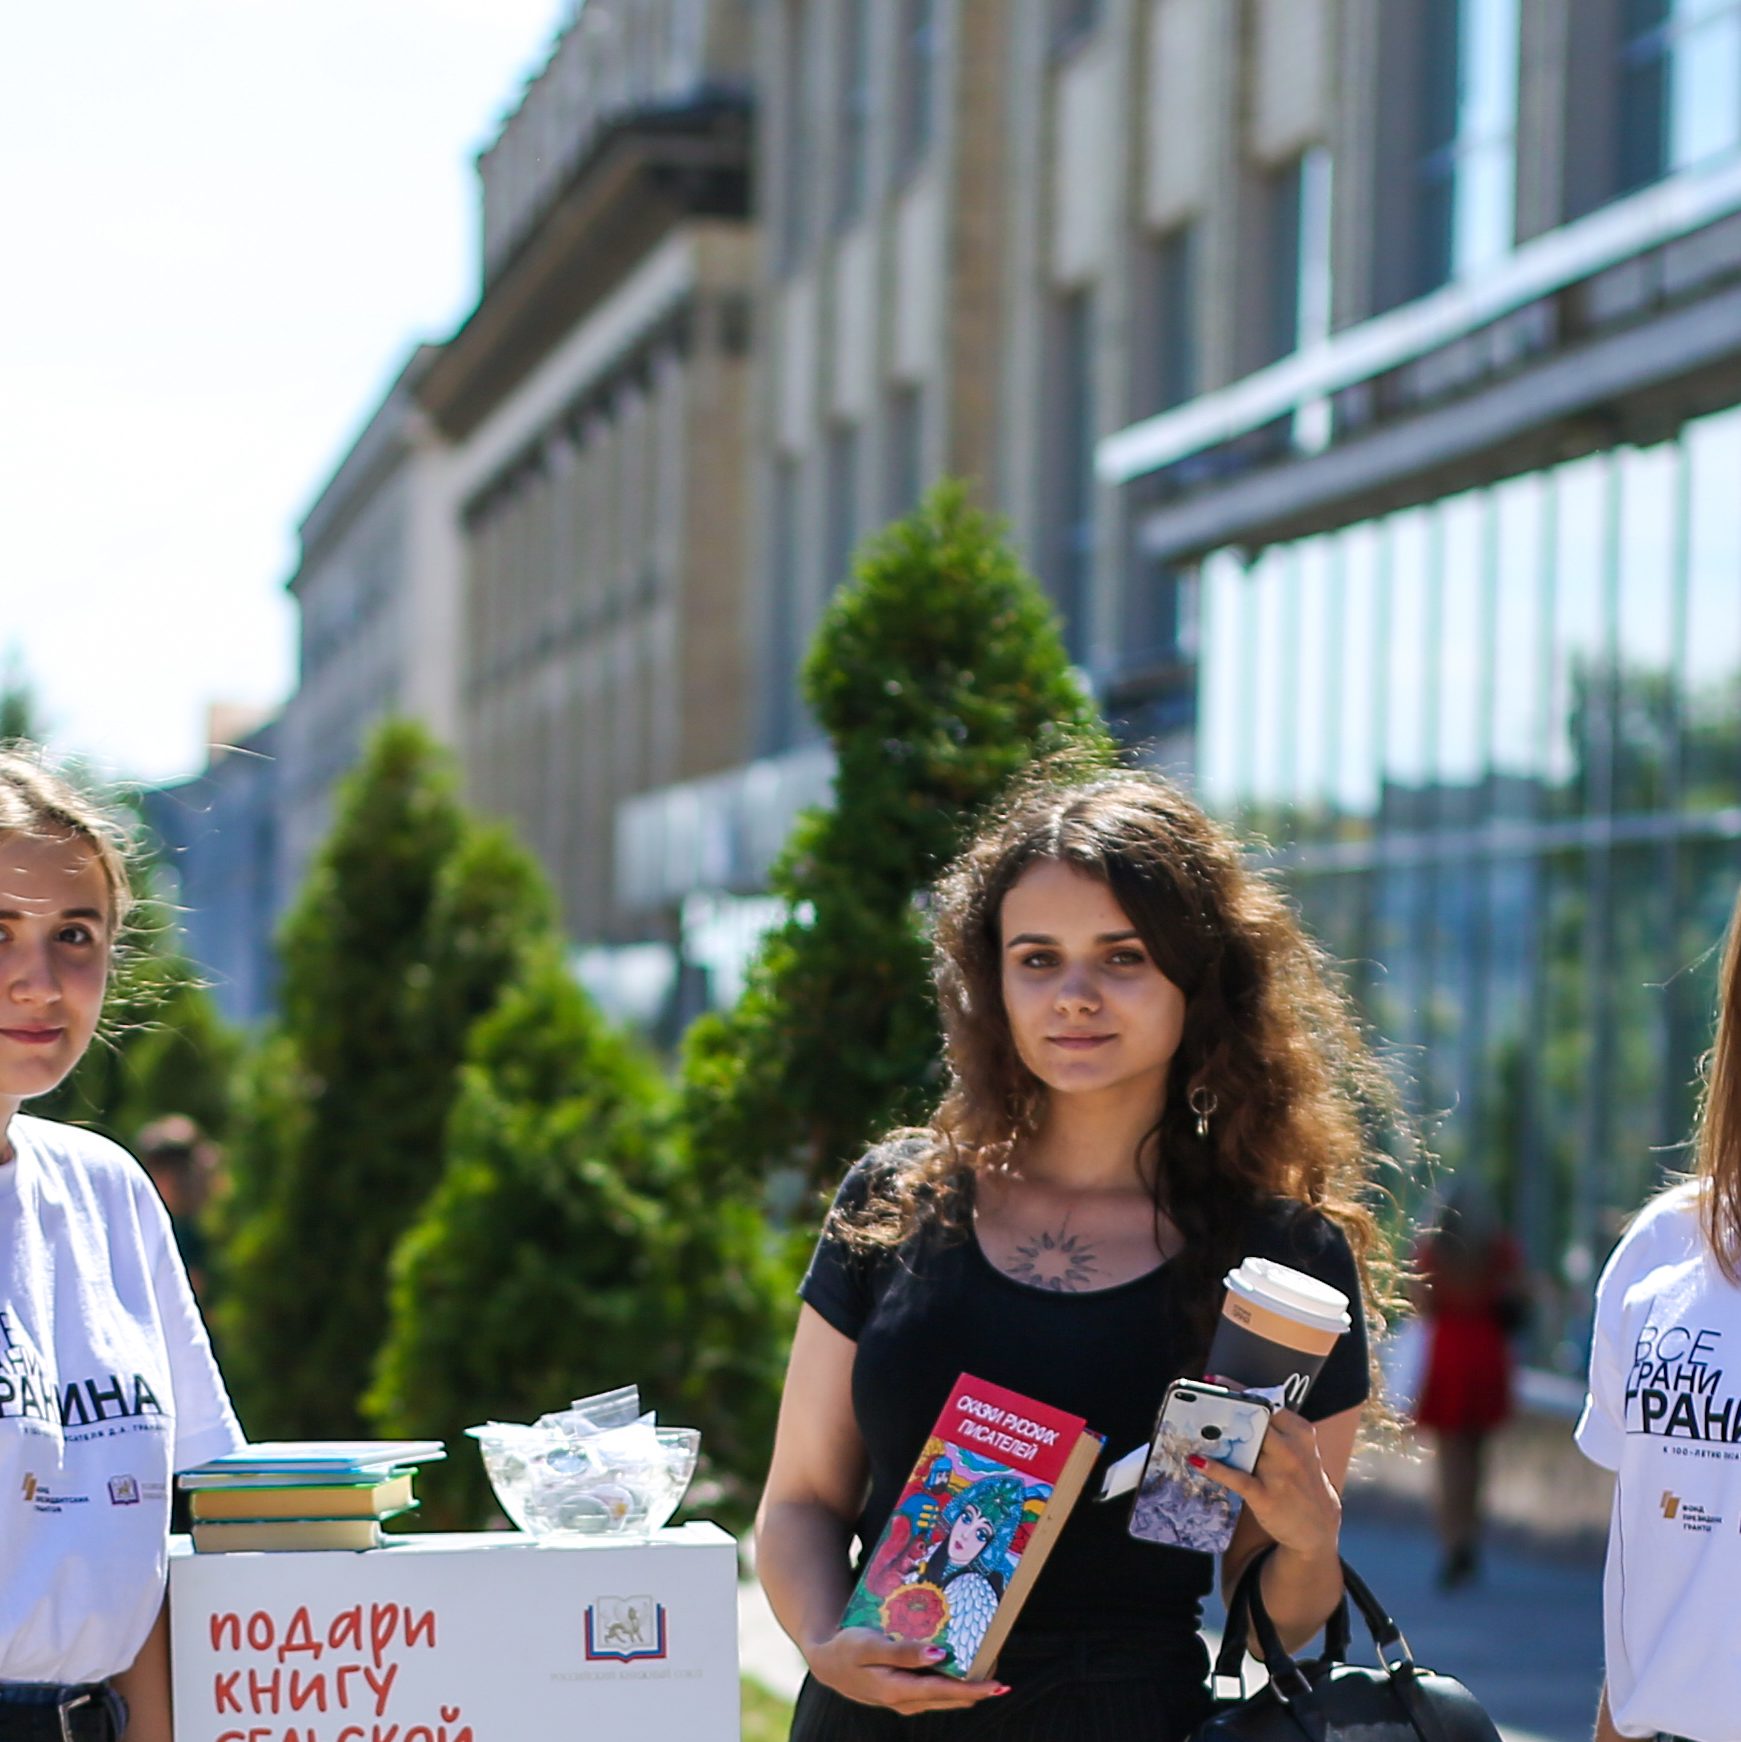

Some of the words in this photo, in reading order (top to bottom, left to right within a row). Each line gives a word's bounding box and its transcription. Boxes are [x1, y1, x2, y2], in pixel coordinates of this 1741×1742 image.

[1635, 1326, 1722, 1366] ВСЕ
[957, 1395, 1005, 1423] СКАЗКИ
[1002, 1413, 1060, 1446] РУССКИХ
[958, 1419, 1038, 1461] ПИСАТЕЛЕЙ
[214, 1663, 398, 1717] КНИГУ
